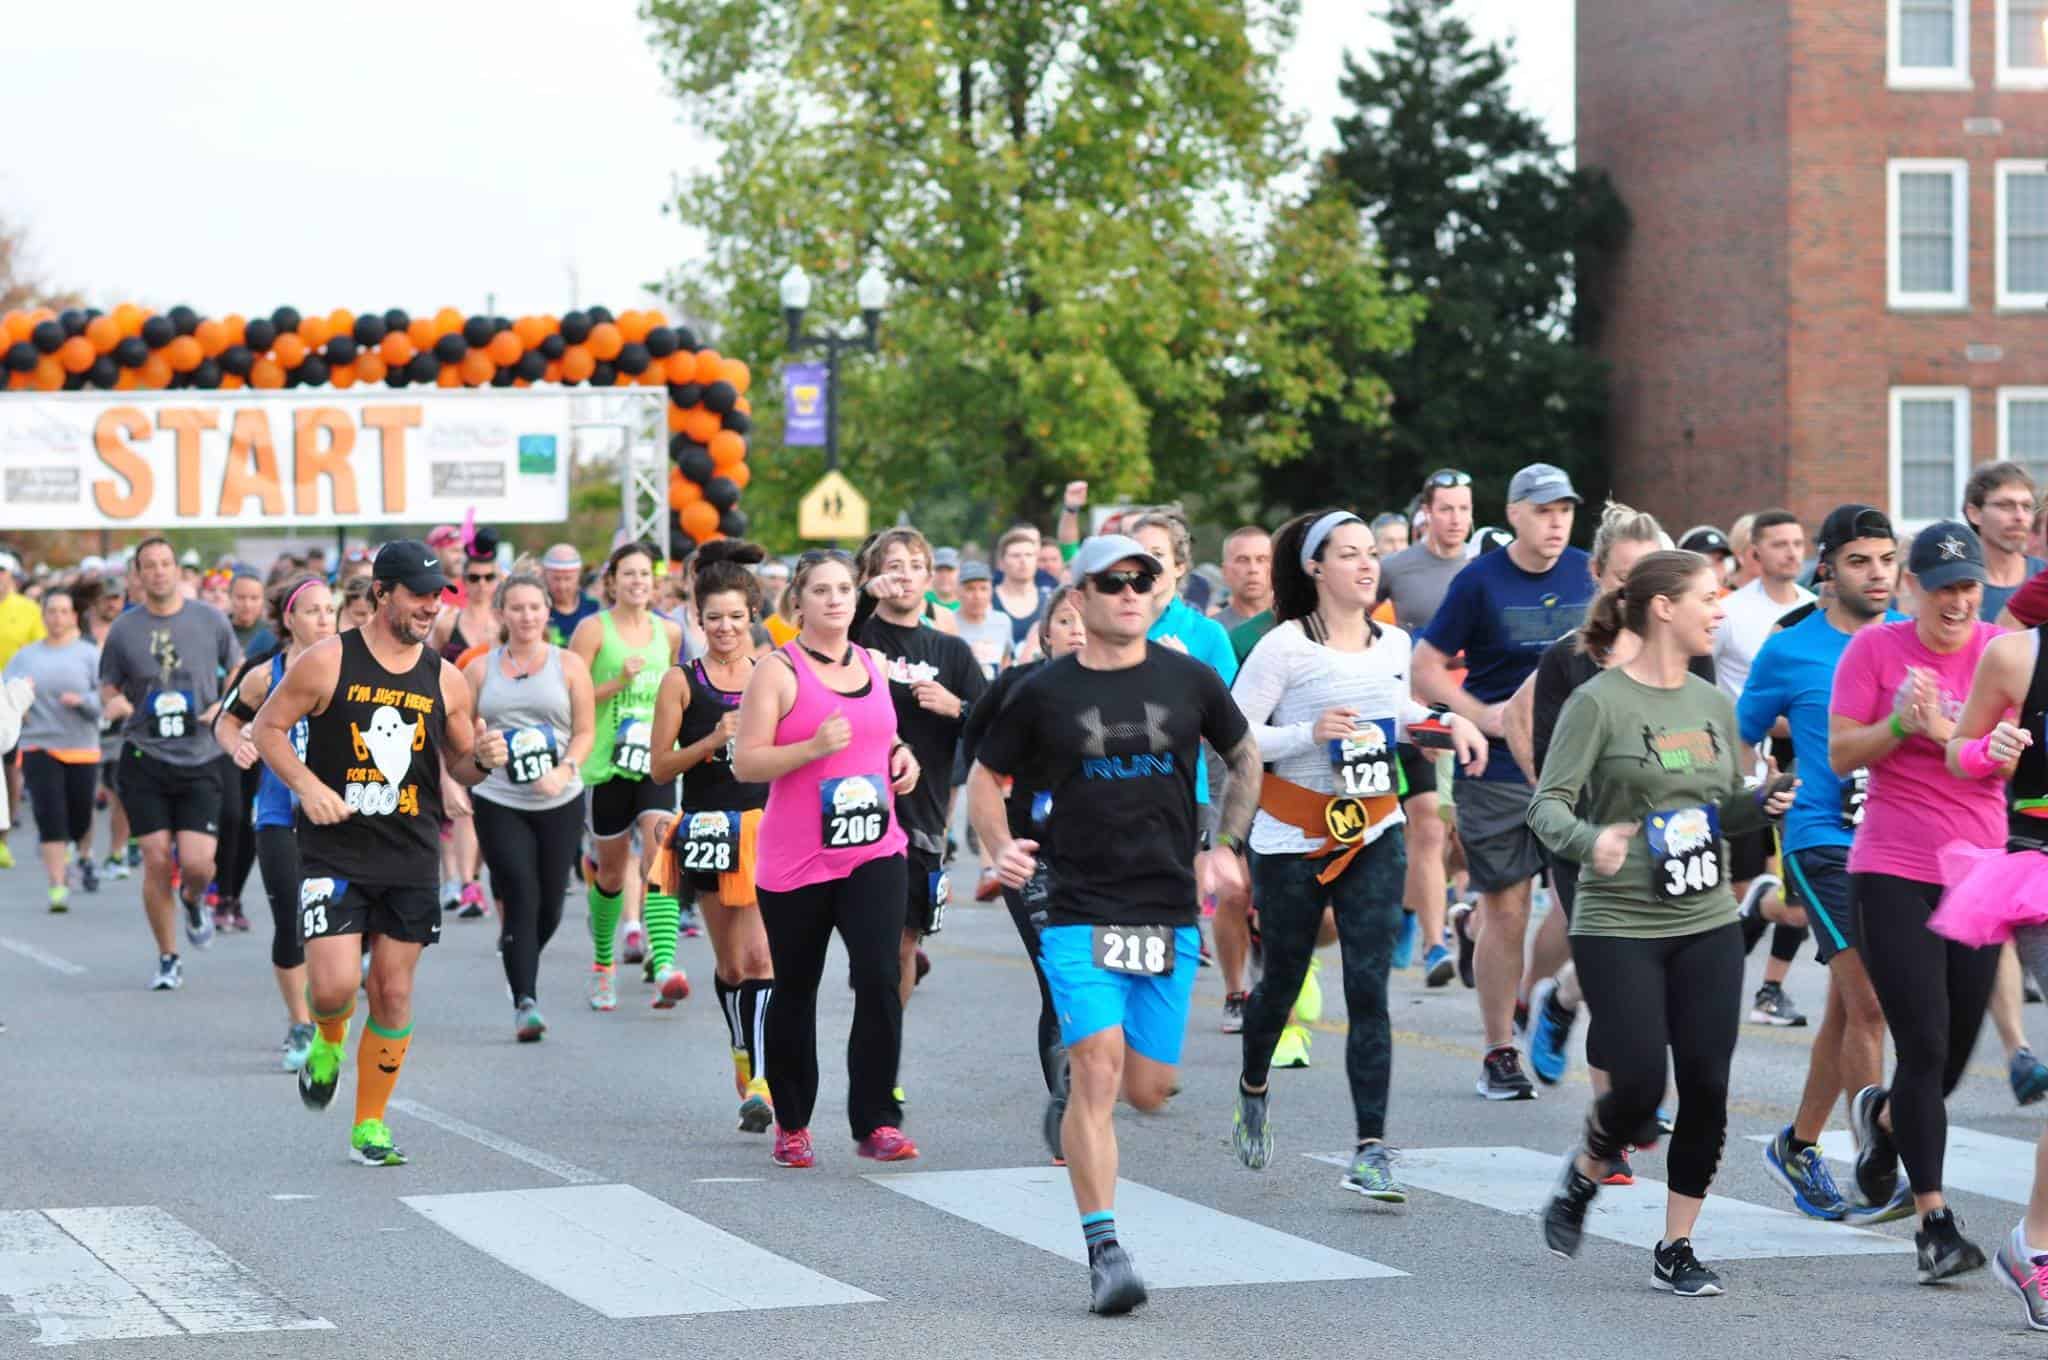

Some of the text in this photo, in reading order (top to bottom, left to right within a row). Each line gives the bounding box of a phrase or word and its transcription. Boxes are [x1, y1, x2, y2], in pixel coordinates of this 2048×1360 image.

[92, 405, 422, 519] START
[372, 687, 405, 706] JUST
[404, 692, 434, 714] HERE
[346, 768, 367, 782] FOR
[1082, 752, 1174, 779] RUN
[1342, 761, 1391, 794] 128
[830, 814, 882, 845] 206
[1331, 803, 1362, 835] M
[684, 841, 730, 870] 228
[1664, 850, 1719, 896] 346
[303, 905, 329, 938] 93
[1103, 933, 1165, 972] 218
